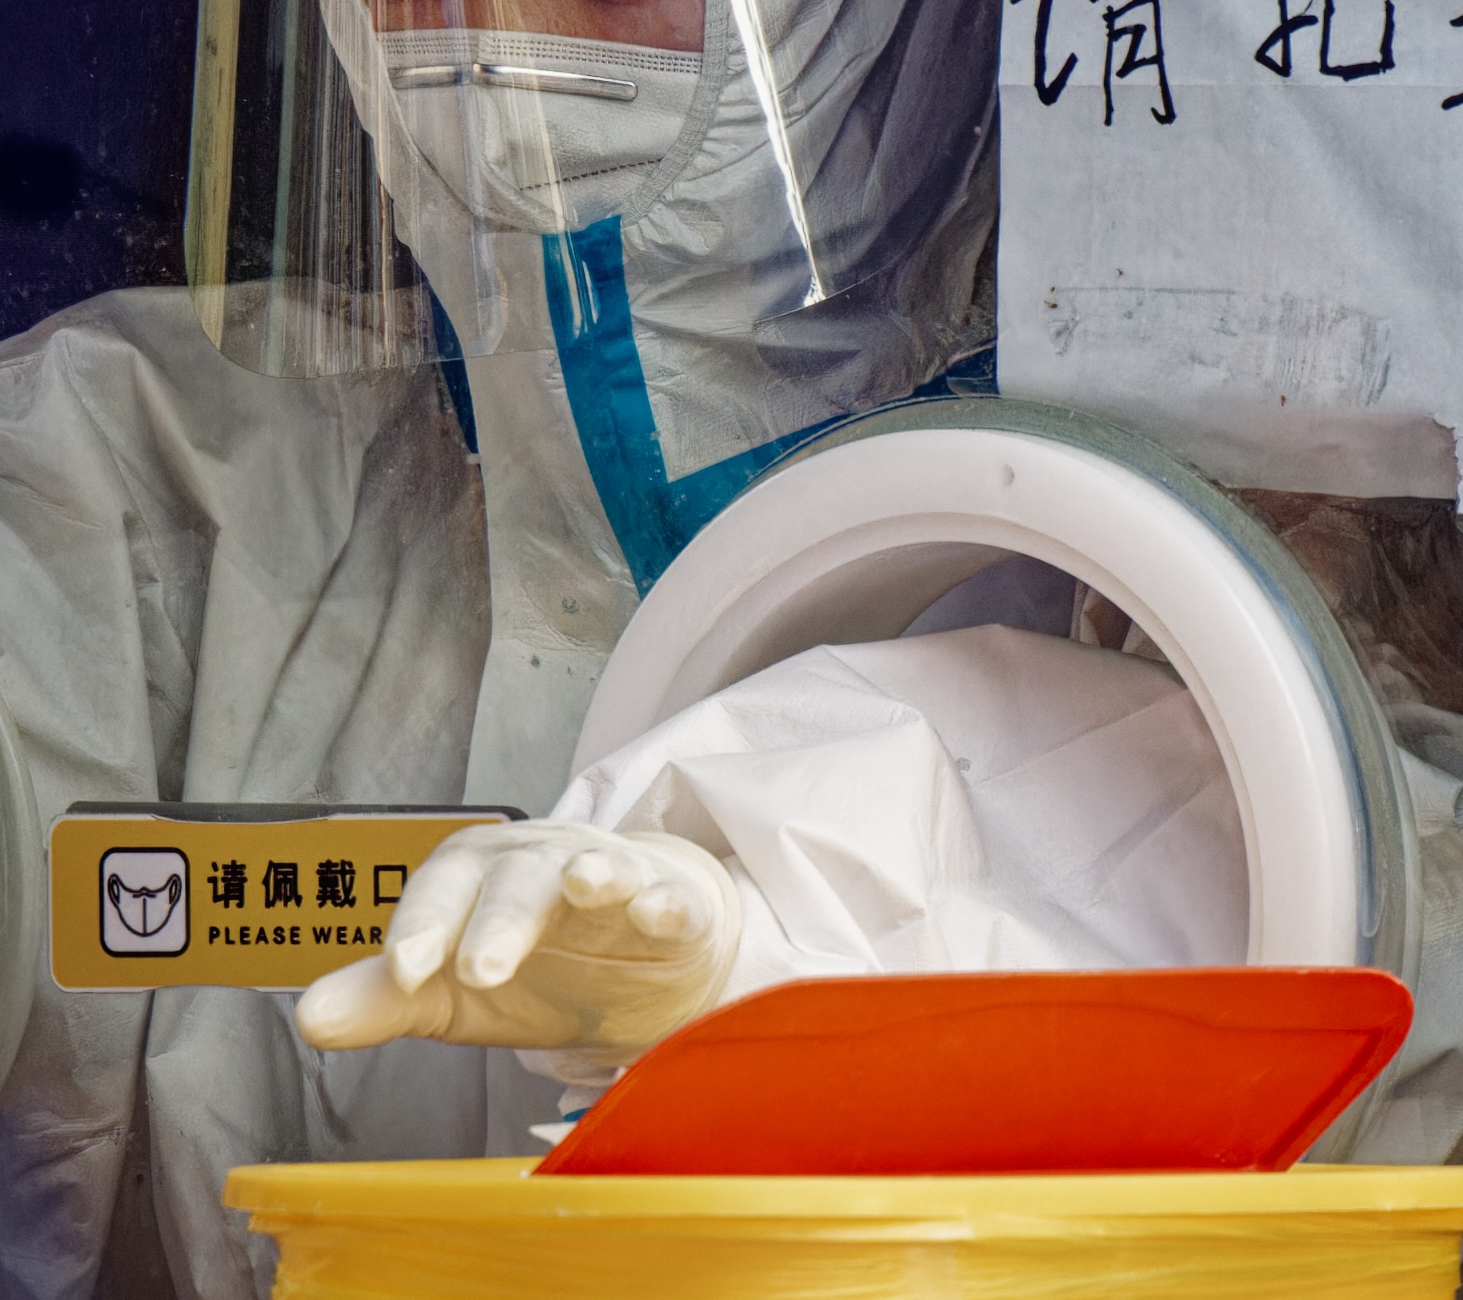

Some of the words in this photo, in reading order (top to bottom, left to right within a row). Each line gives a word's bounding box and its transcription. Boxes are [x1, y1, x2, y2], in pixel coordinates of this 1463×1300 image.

[206, 859, 408, 909] 请佩戴口
[208, 926, 302, 946] PLEASE
[312, 926, 384, 946] WEAR
